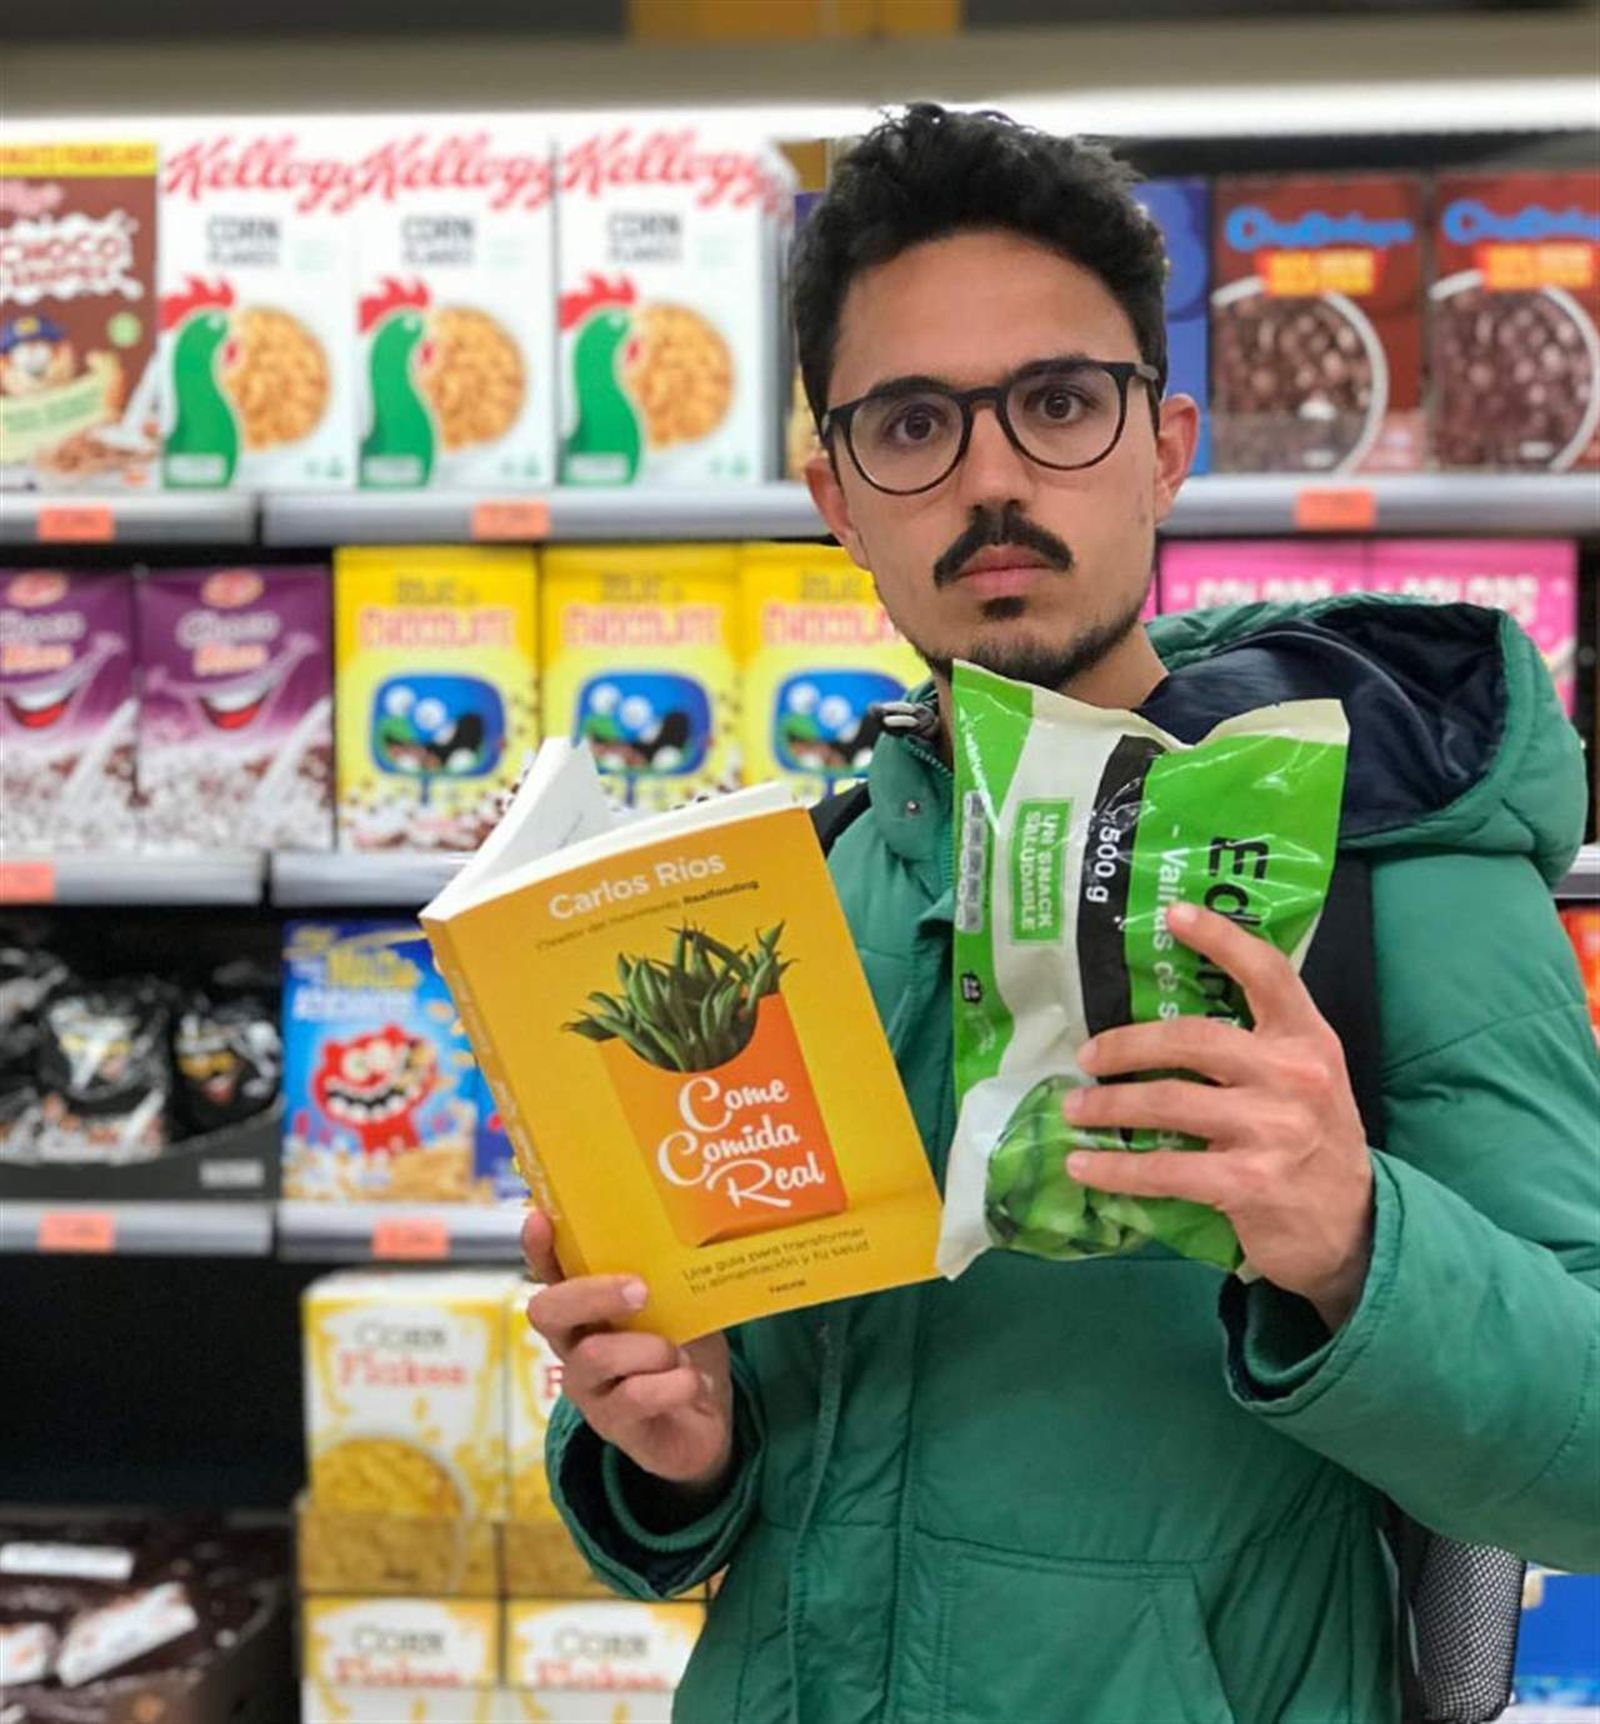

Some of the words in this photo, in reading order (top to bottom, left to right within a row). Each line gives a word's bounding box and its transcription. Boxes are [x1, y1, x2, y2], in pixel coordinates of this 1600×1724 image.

[1019, 810, 1043, 932] SALUDABLE
[1093, 825, 1122, 879] 500
[549, 874, 649, 920] Carlos
[1036, 851, 1054, 929] SNACK
[1085, 884, 1110, 904] g
[678, 1076, 789, 1133] Come
[657, 1114, 800, 1186] Comida
[706, 1151, 826, 1208] Real
